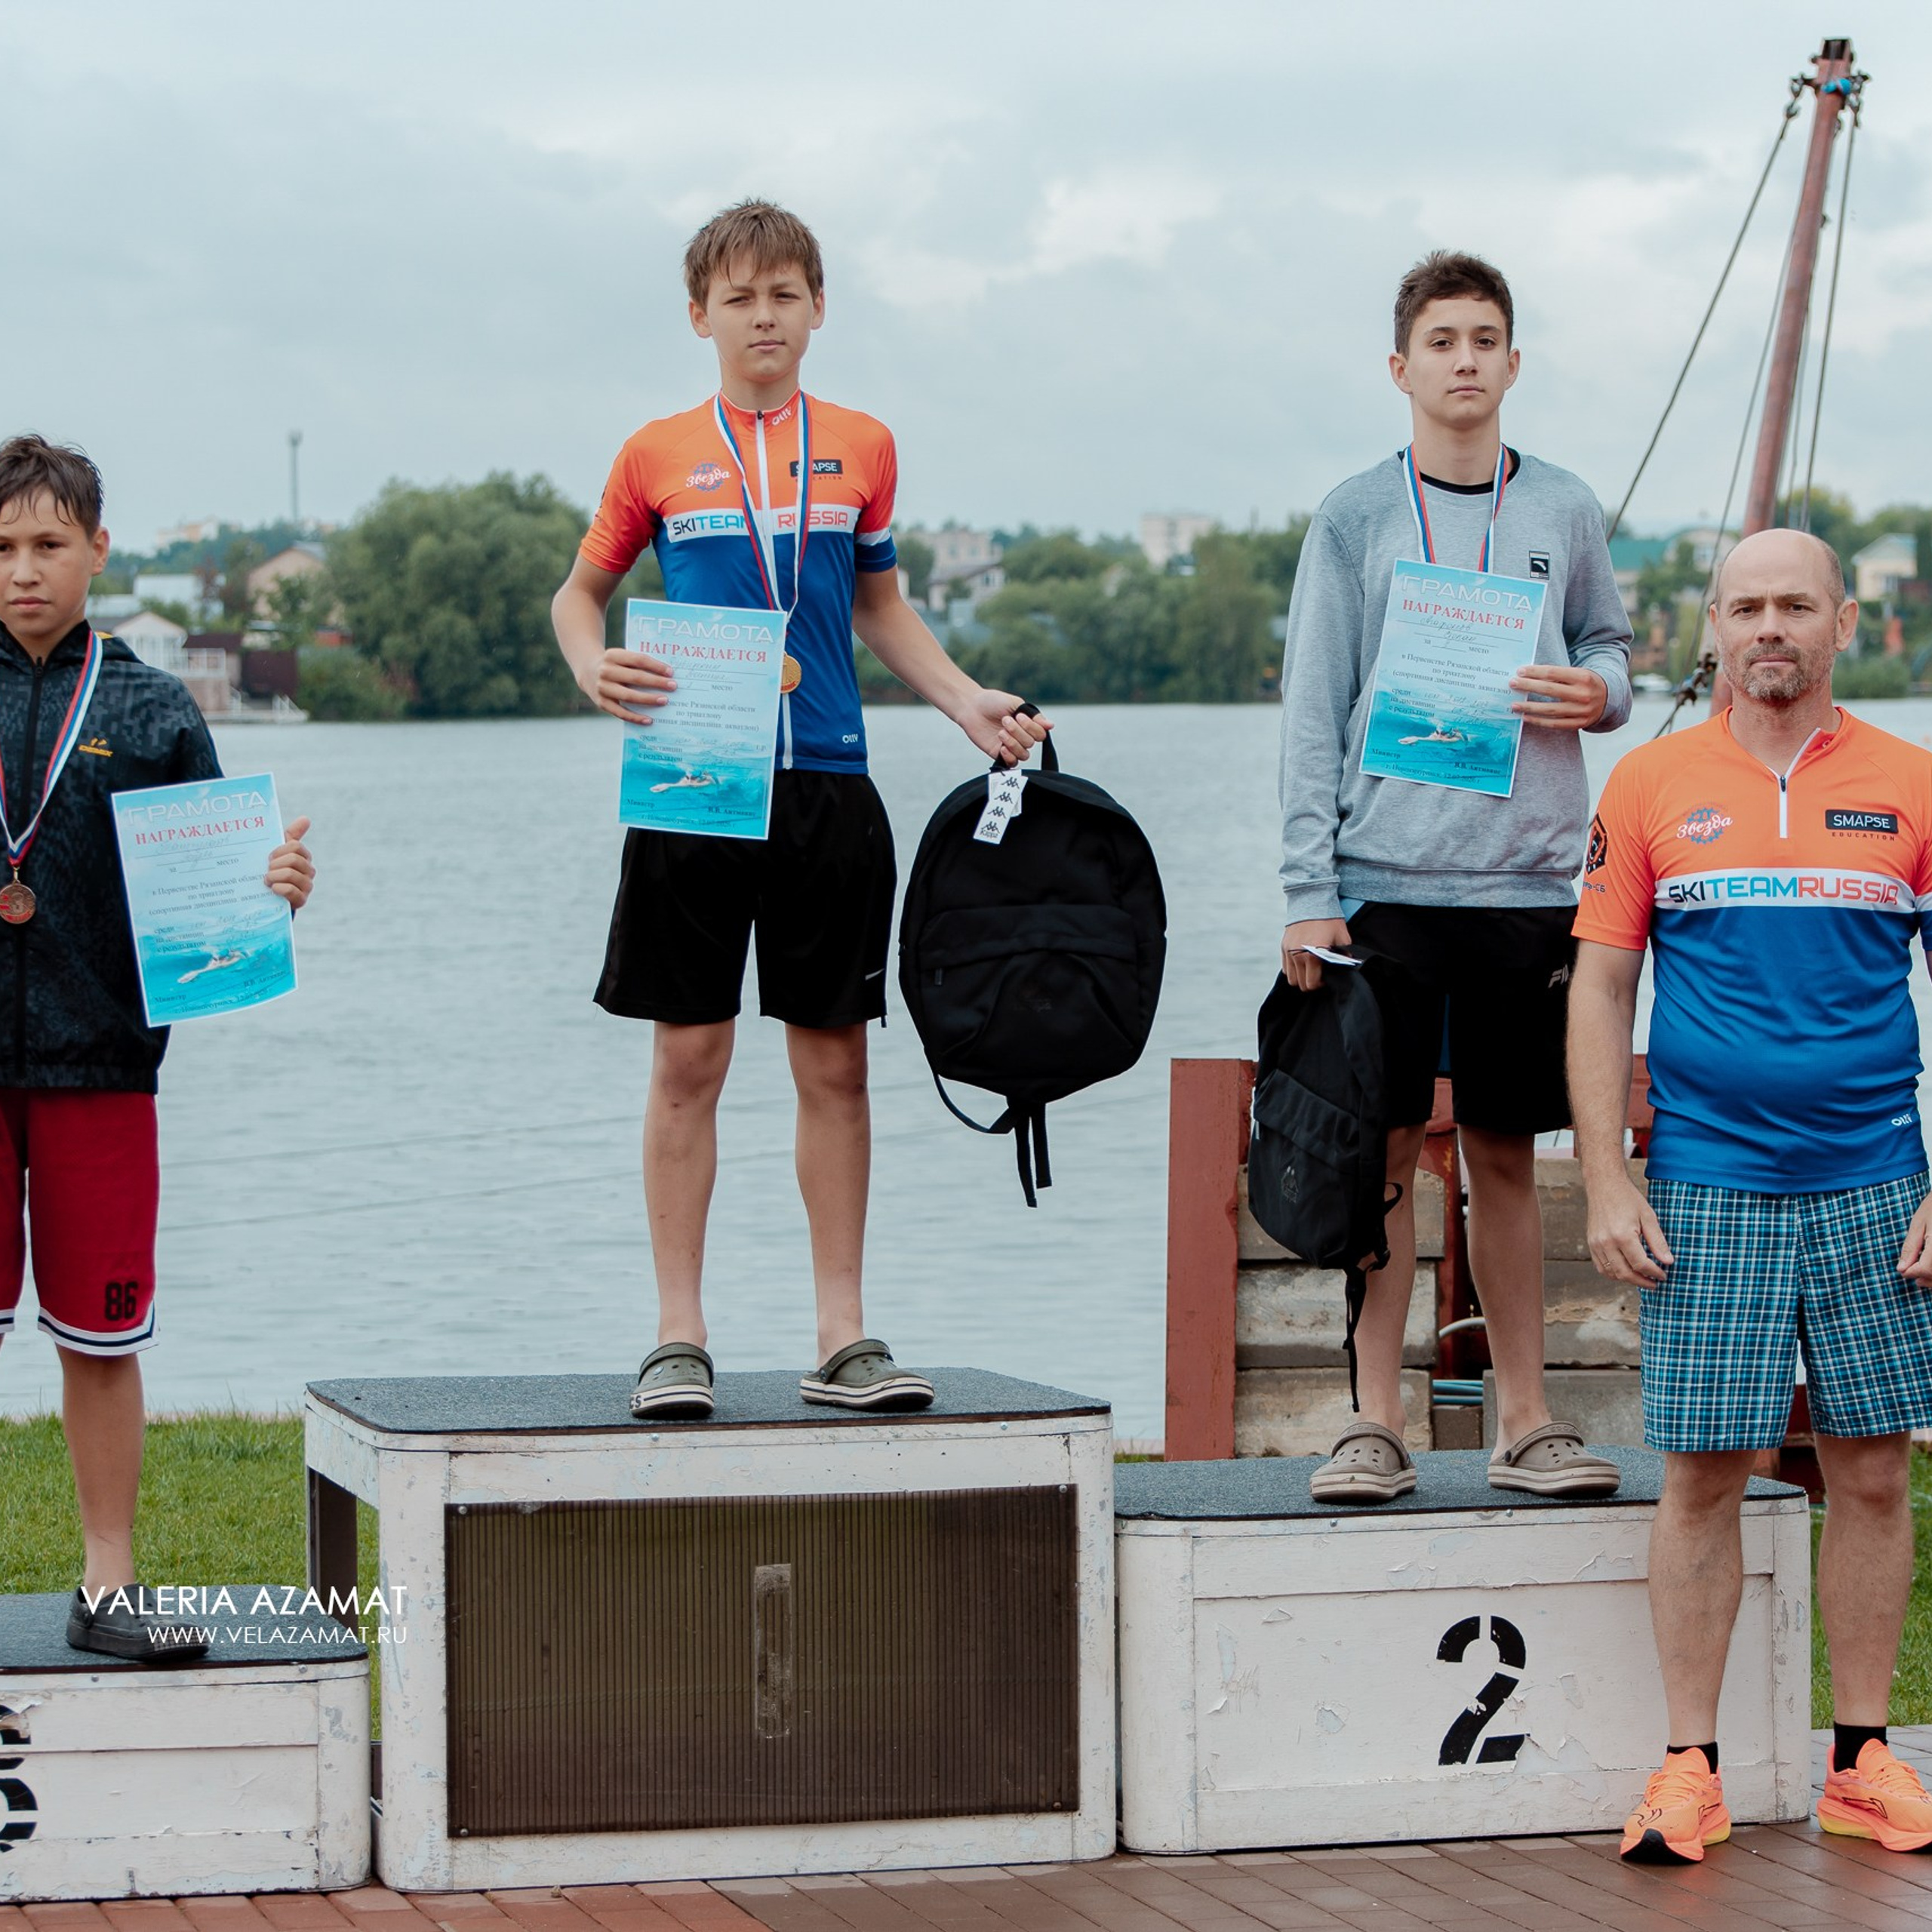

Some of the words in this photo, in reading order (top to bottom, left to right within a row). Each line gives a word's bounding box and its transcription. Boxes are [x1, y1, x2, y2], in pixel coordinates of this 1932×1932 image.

[685, 467, 731, 488] Звезда
[1402, 574, 1534, 612] ГРАМОТА
[1403, 600, 1524, 629] НАГРАЖДАЕТСЯ
[638, 616, 774, 644] ГРАМОТА
[641, 641, 767, 663] НАГРАЖДАЕТСЯ
[1469, 646, 1489, 655] место
[1407, 654, 1446, 666] Первенстве
[1447, 660, 1481, 672] Рязанской
[1482, 666, 1509, 677] области
[1442, 669, 1476, 681] триатлону
[711, 684, 733, 692] место
[687, 711, 721, 720] триатлону
[691, 701, 726, 712] Рязанской
[728, 704, 756, 713] области
[1371, 748, 1401, 759] Министр
[127, 791, 269, 826] ГРАМОТА
[136, 816, 265, 844] НАГРАЖДАЕТСЯ
[1676, 814, 1733, 838] Звезда
[1833, 814, 1890, 829] SMAPSE
[1832, 832, 1895, 841] EDUCATION
[217, 858, 239, 866] место
[199, 877, 238, 890] Рязанской
[1669, 876, 1899, 905] SKITEAMRUSSIA
[104, 1281, 139, 1321] 86
[1436, 1615, 1531, 1766] 2
